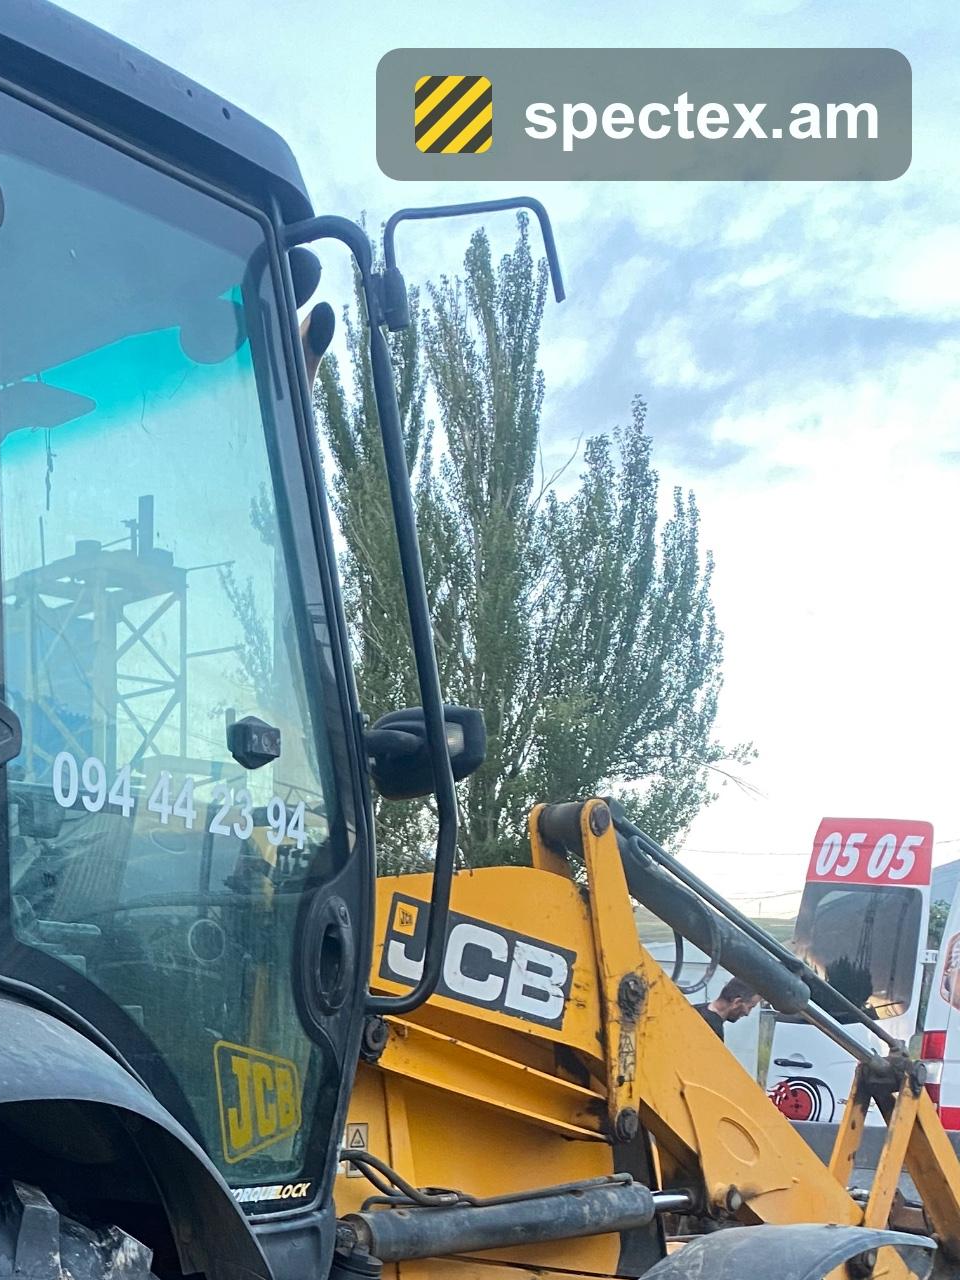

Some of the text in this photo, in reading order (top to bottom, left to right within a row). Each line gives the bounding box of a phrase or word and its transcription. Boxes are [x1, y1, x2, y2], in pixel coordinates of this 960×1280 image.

[52, 751, 308, 849] 094 44 23 94
[815, 832, 924, 880] 05 05
[228, 1055, 296, 1150] JCB
